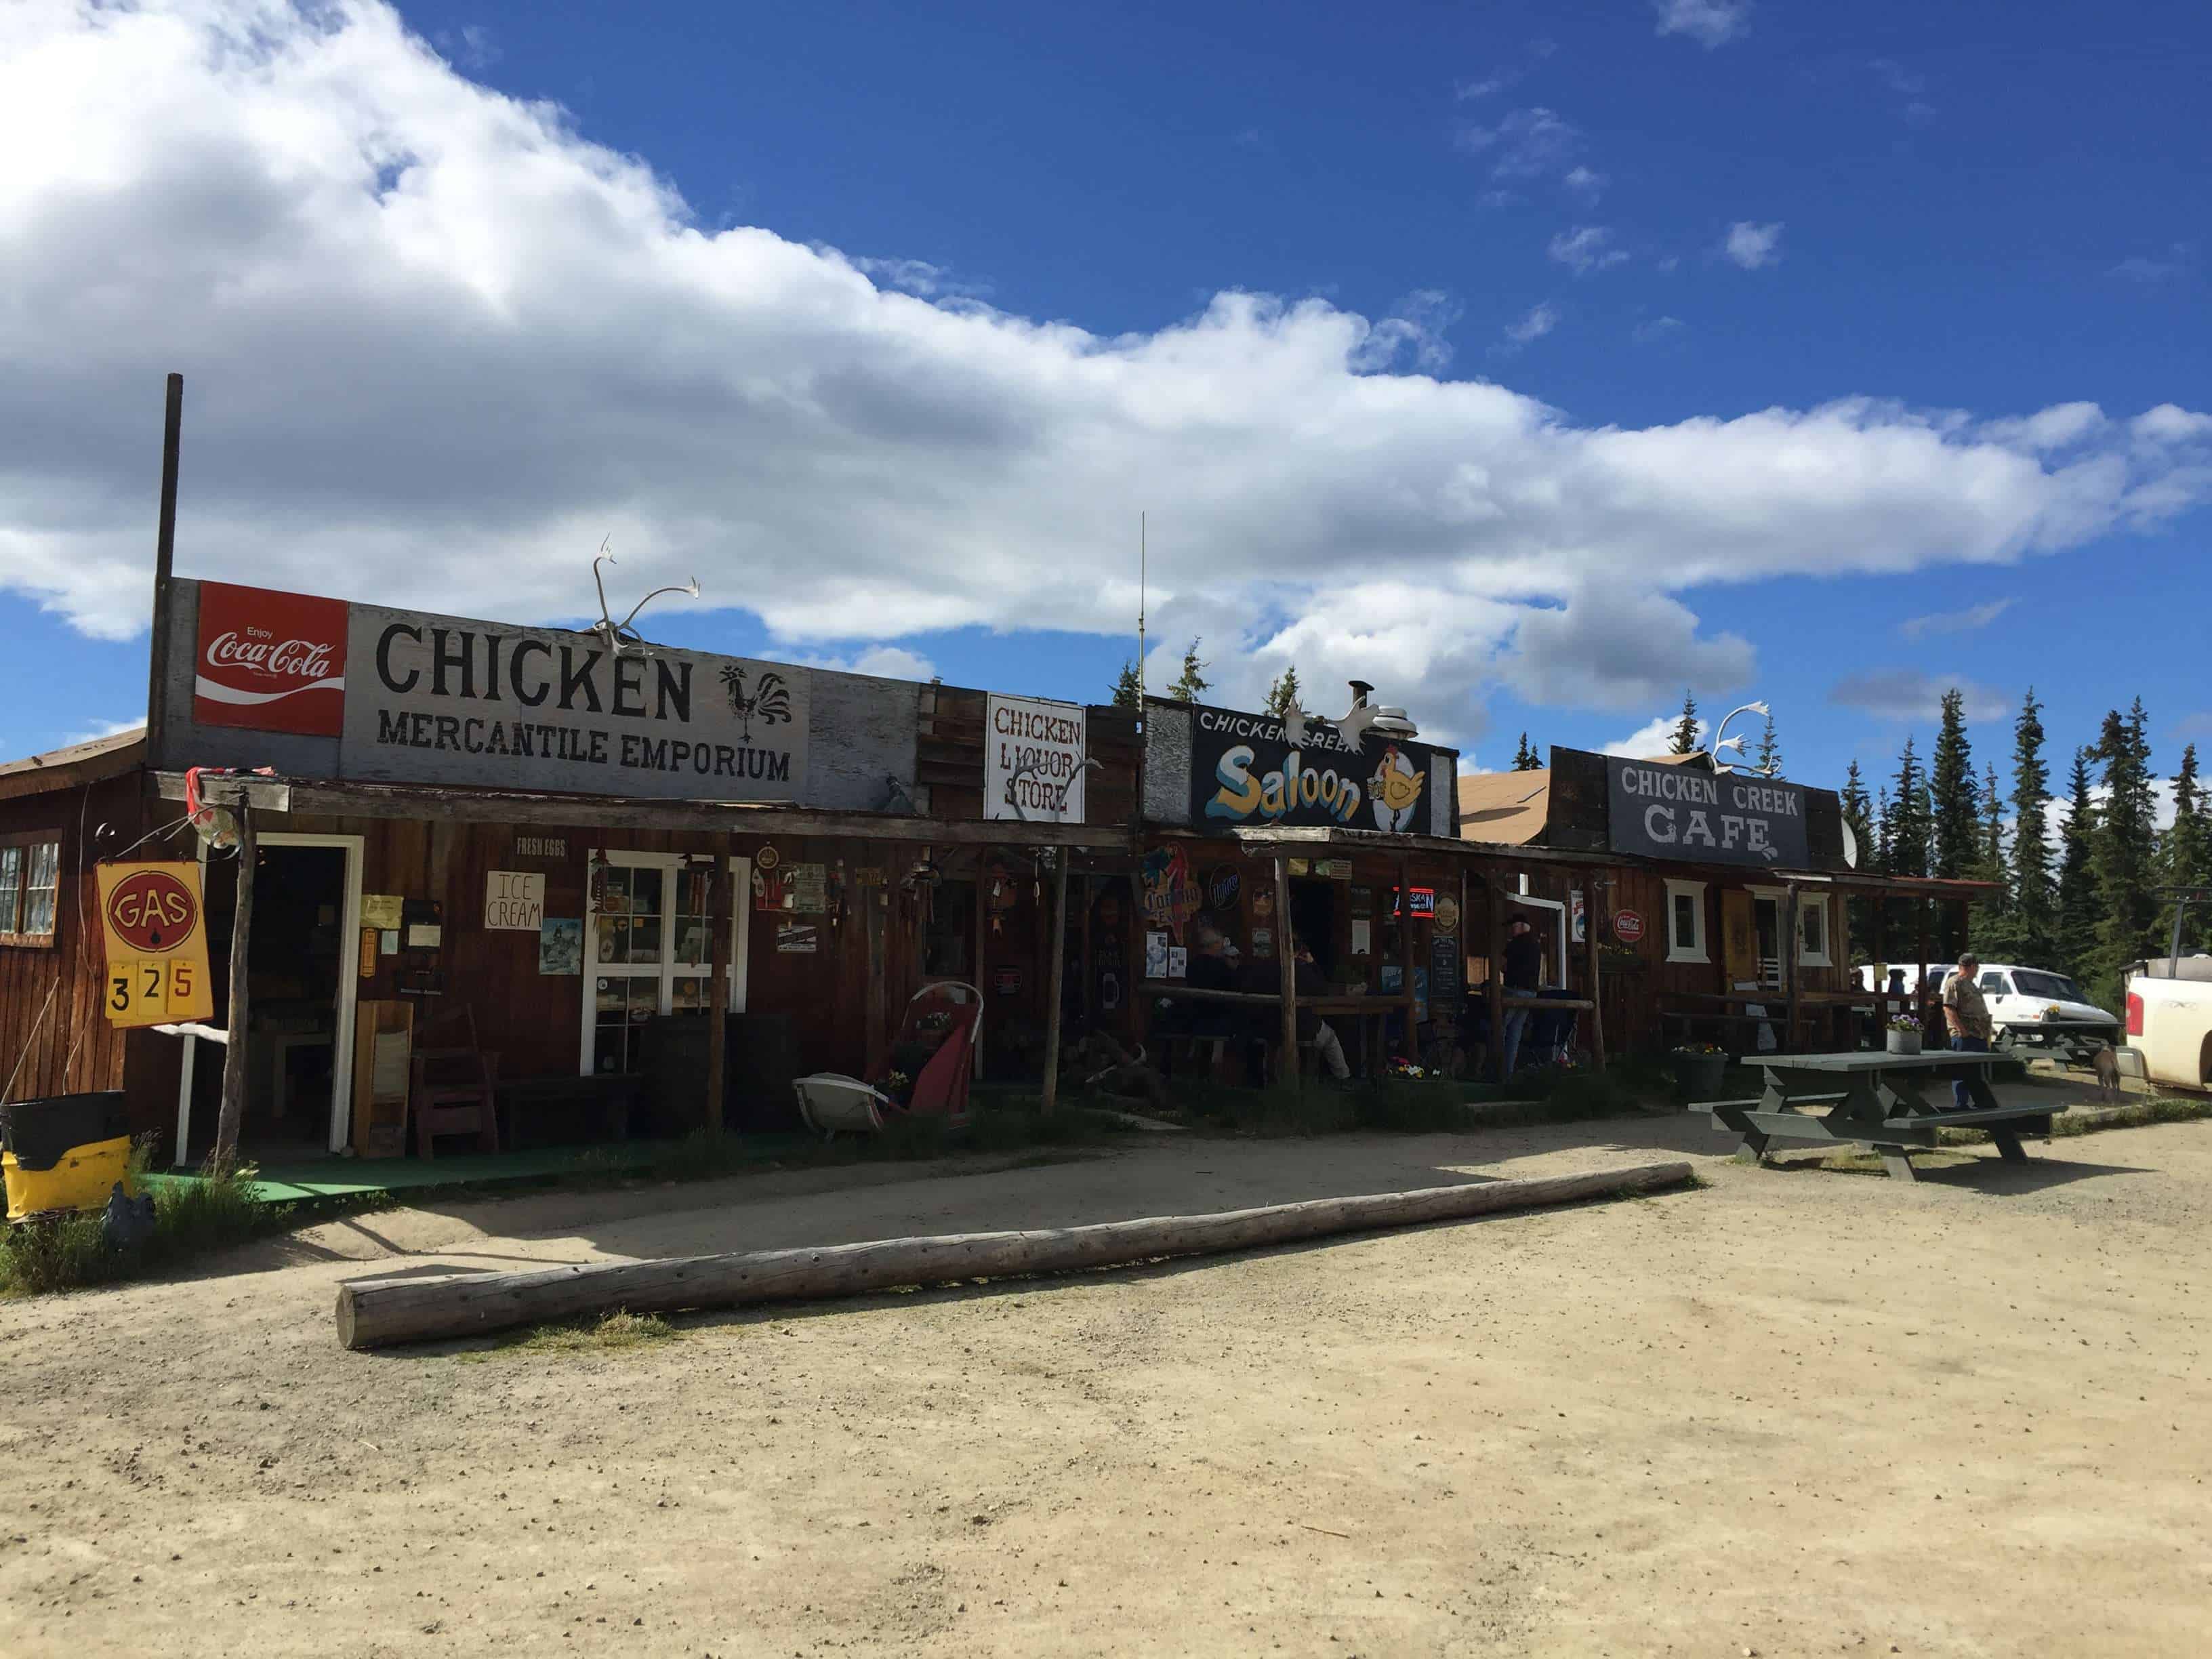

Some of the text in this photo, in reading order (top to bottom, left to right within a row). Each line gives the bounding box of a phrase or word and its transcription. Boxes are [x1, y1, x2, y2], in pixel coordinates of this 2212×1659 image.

[247, 626, 273, 639] Enjoy
[207, 632, 335, 677] Coca-Cola
[376, 623, 693, 722] CHICKEN
[377, 710, 791, 782] MERCANTILE EMPORIUM
[994, 707, 1081, 745] CHICKEN
[1204, 745, 1361, 823] Saloon
[1621, 766, 1798, 816] CHICKEN CREEK
[516, 836, 565, 857] FRESH EGGS
[1645, 804, 1771, 853] CAFE
[498, 874, 533, 900] ICE
[115, 889, 188, 928] GAS
[488, 901, 541, 927] CREAM
